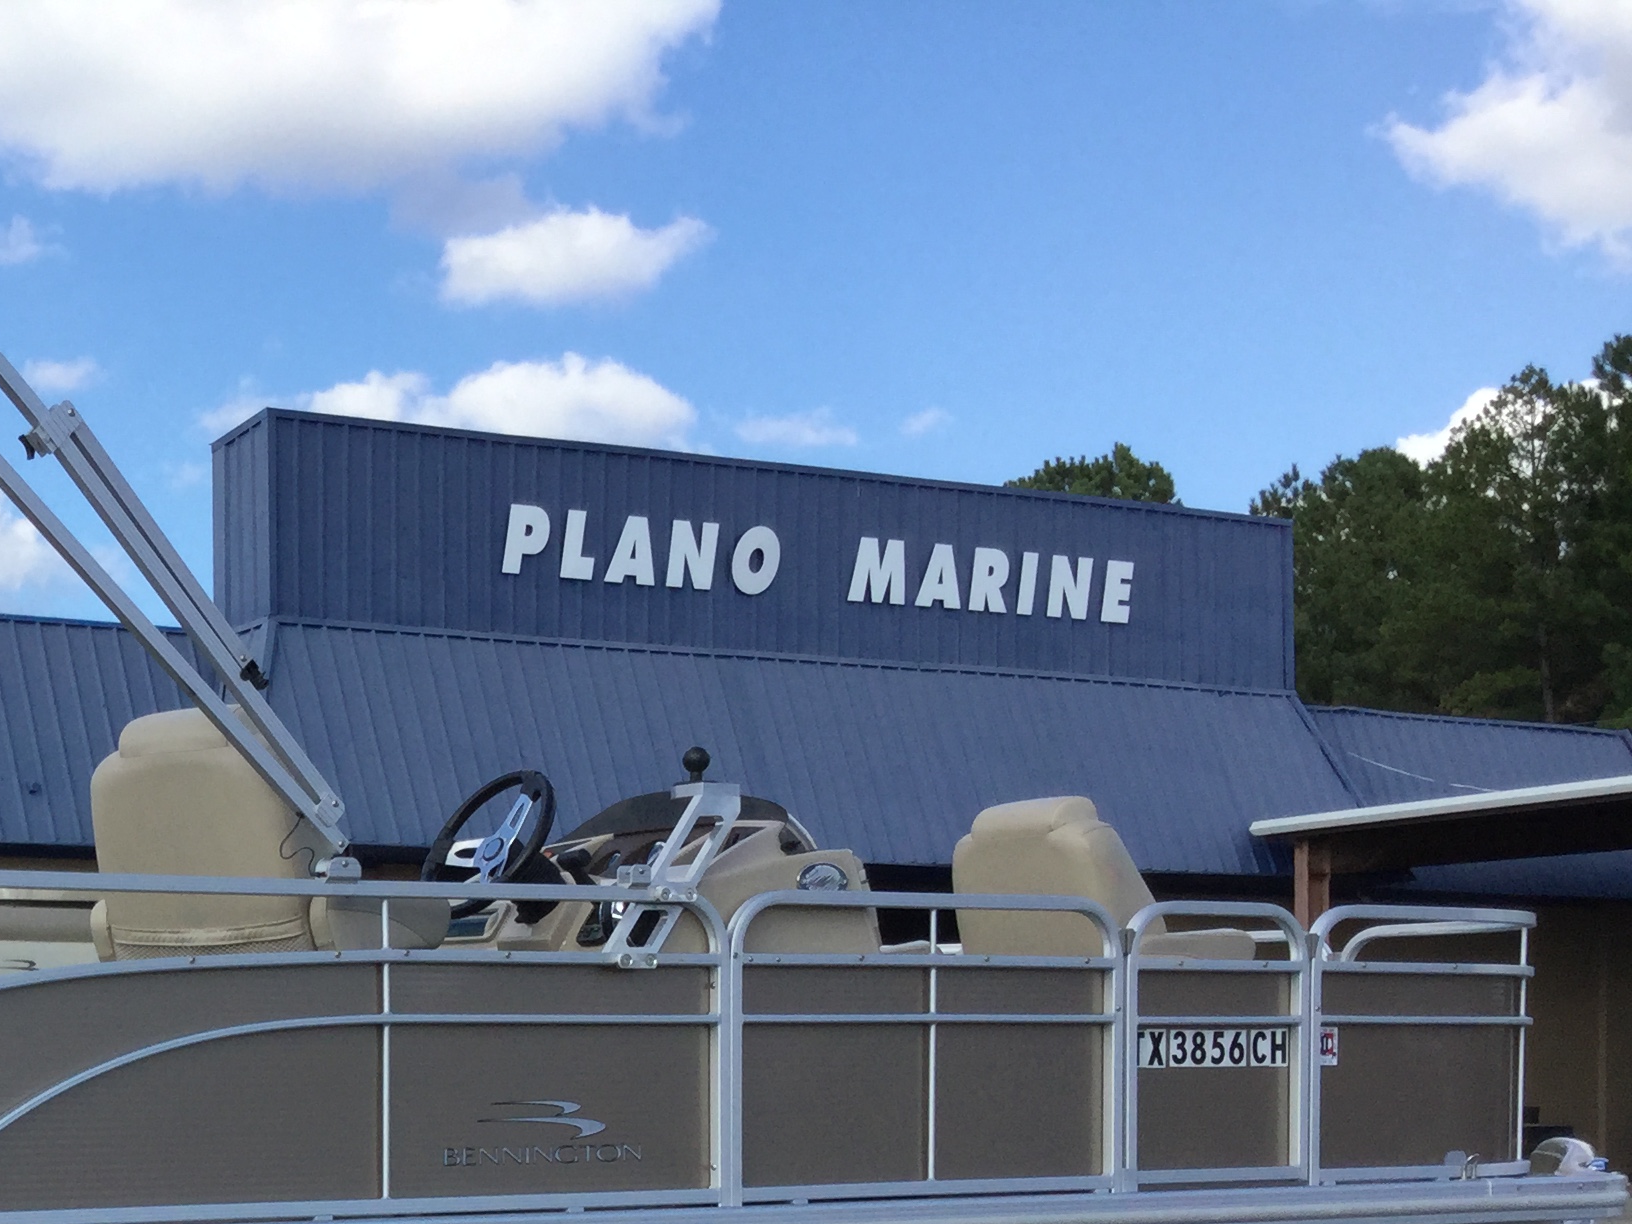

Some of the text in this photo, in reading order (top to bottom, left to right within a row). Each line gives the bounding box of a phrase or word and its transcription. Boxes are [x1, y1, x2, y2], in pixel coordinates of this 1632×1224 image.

[501, 503, 1135, 624] PLANO MARINE
[1171, 1030, 1246, 1066] 3856
[1252, 1030, 1287, 1065] CH
[443, 1143, 643, 1168] BENNINGTON
